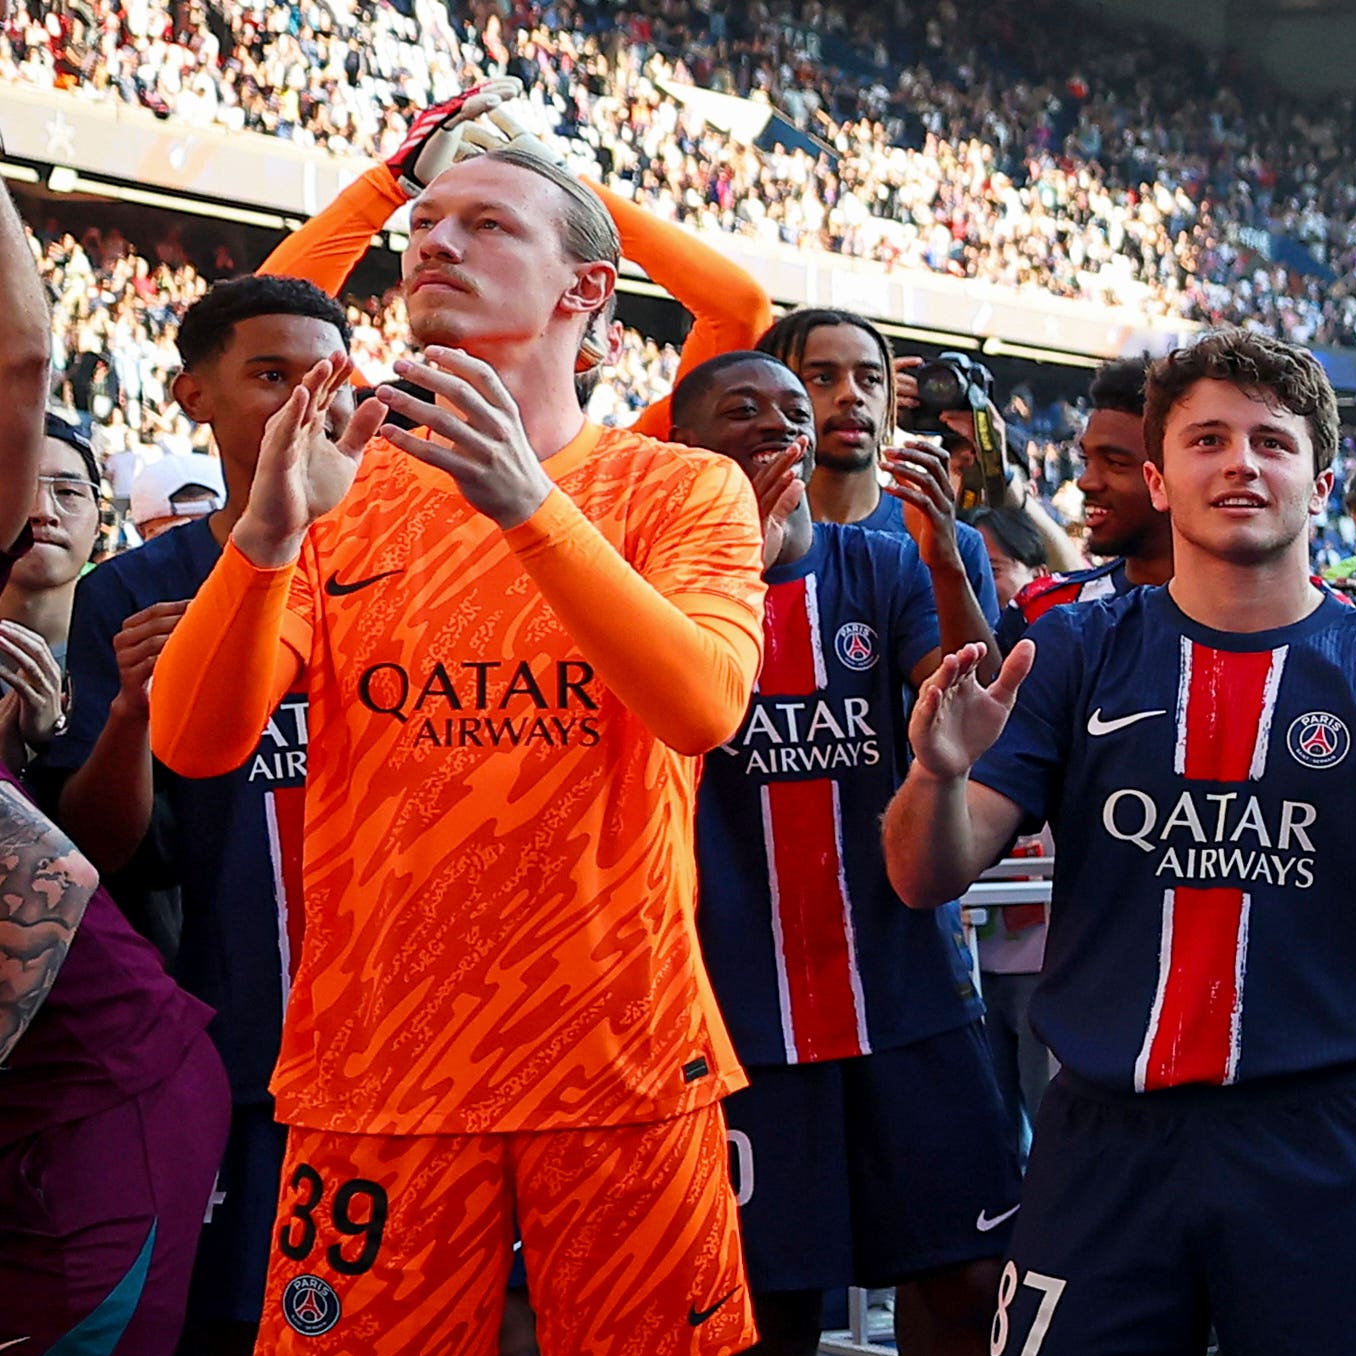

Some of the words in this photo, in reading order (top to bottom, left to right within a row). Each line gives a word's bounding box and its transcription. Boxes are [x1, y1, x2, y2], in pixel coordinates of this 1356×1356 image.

[840, 625, 870, 637] PARIS
[358, 660, 599, 723] QATAR
[413, 716, 600, 747] AIRWAYS
[720, 698, 877, 757] ATAR
[1301, 715, 1342, 732] PARIS
[745, 740, 880, 775] AIRWAYS
[1102, 789, 1318, 853] QATAR
[1155, 847, 1315, 889] AIRWAYS
[280, 1163, 389, 1276] 39
[293, 1280, 329, 1297] PARIS
